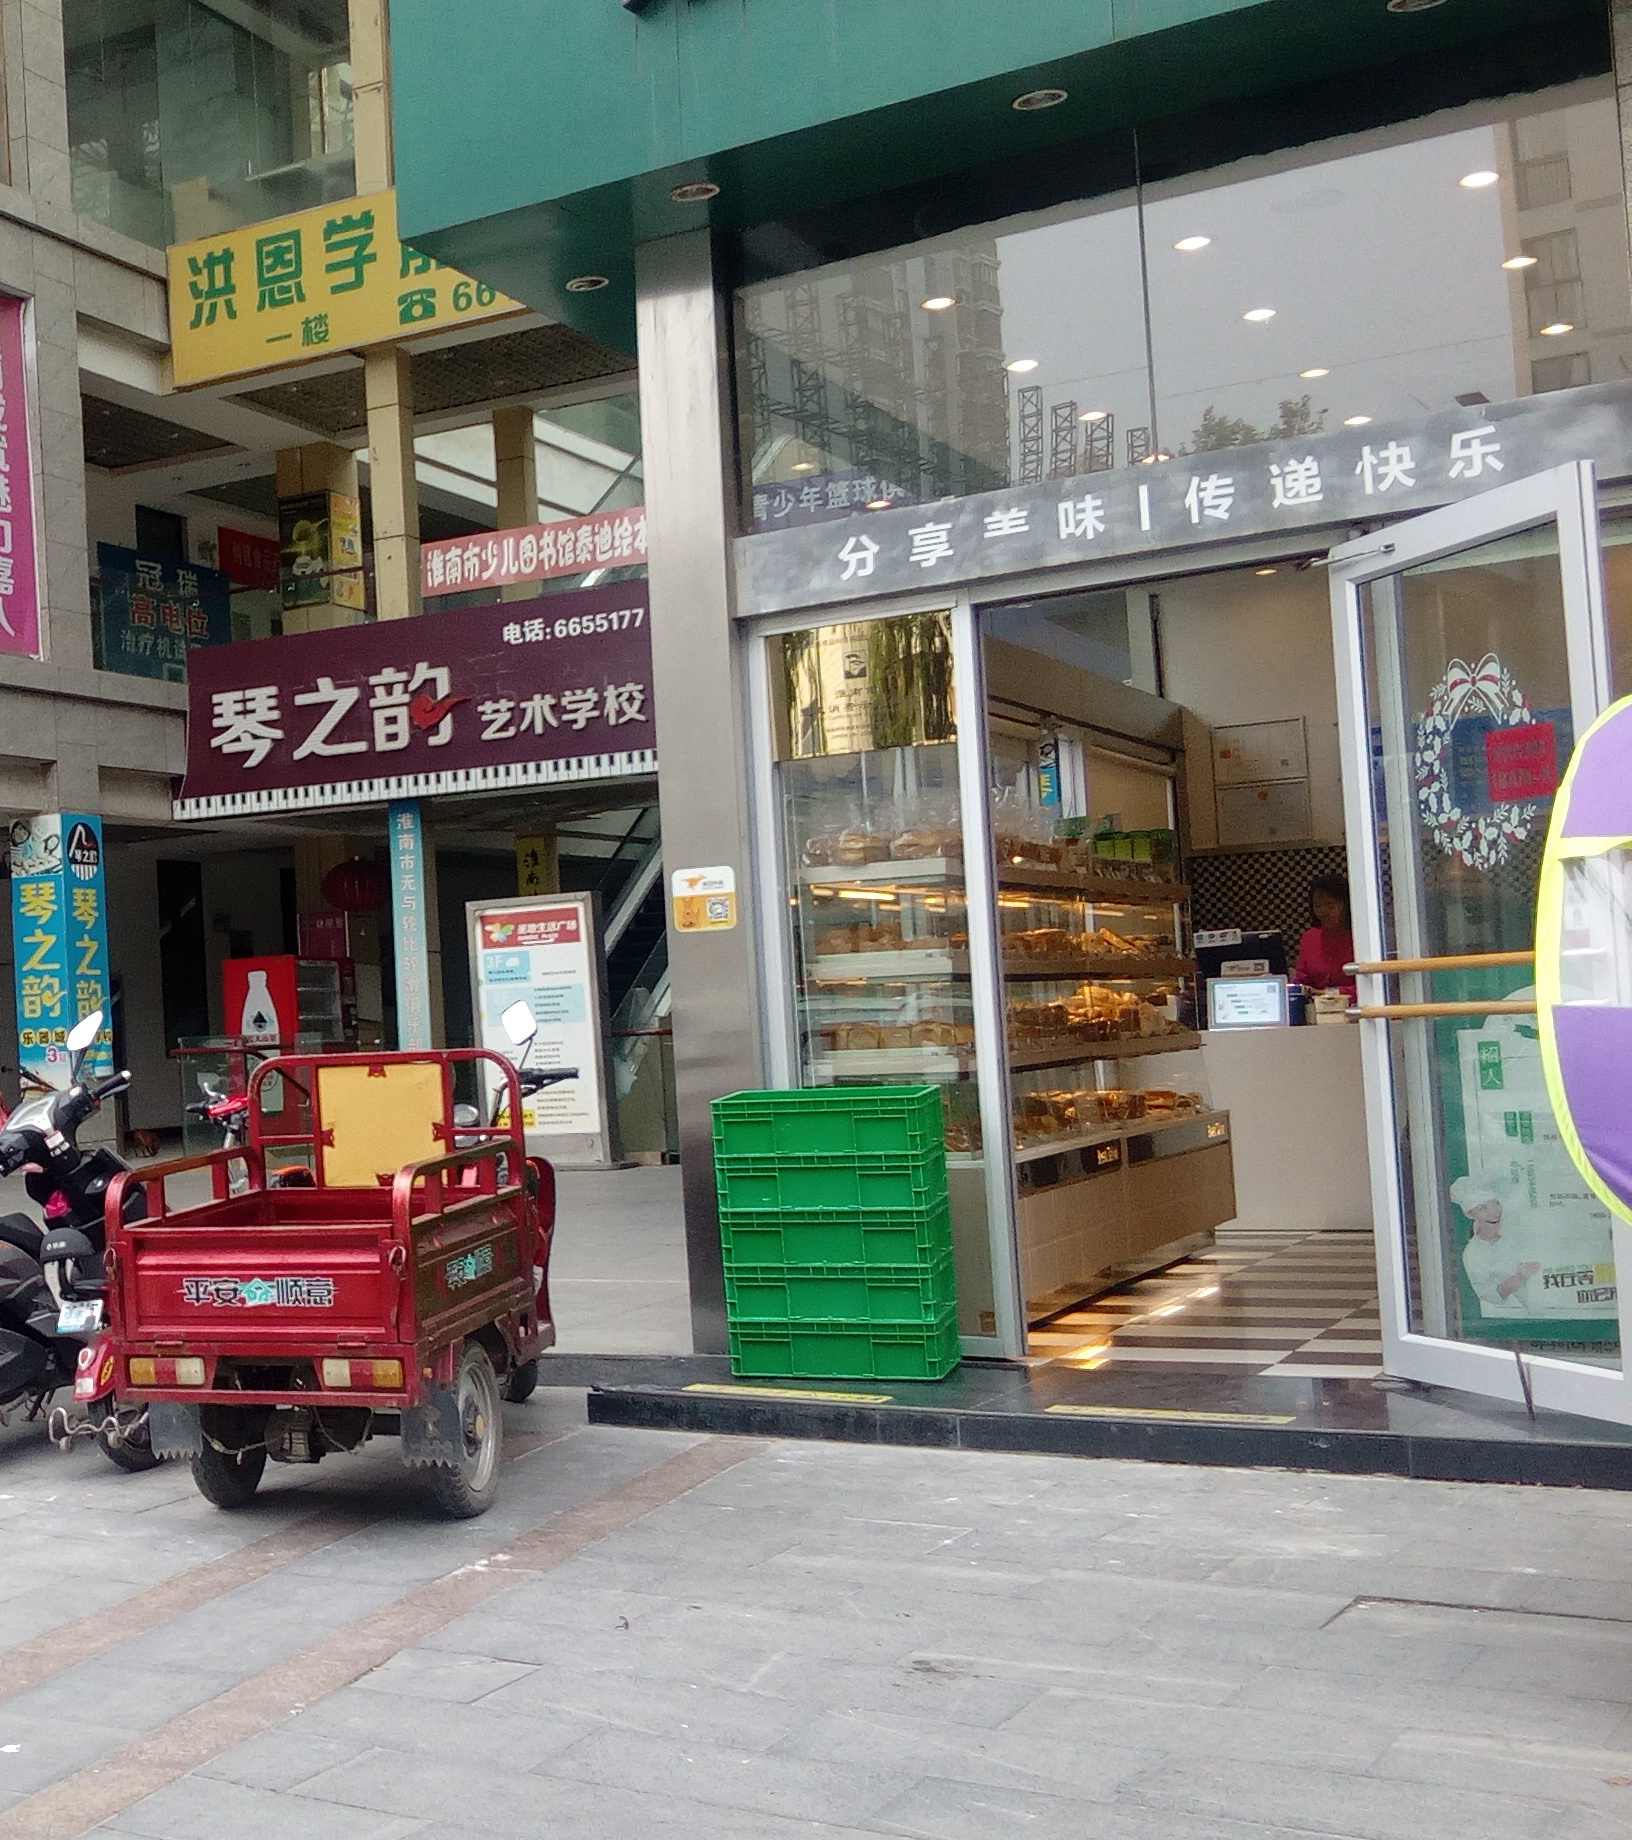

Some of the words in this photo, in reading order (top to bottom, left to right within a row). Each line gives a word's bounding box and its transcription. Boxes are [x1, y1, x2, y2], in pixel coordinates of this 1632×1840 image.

[265, 312, 330, 347] 一楼
[130, 594, 210, 640] 高电位
[211, 661, 454, 769] 琴之韵
[477, 682, 649, 742] 艺术学校
[18, 880, 67, 1019] 琴之韵
[485, 954, 503, 969] 3F
